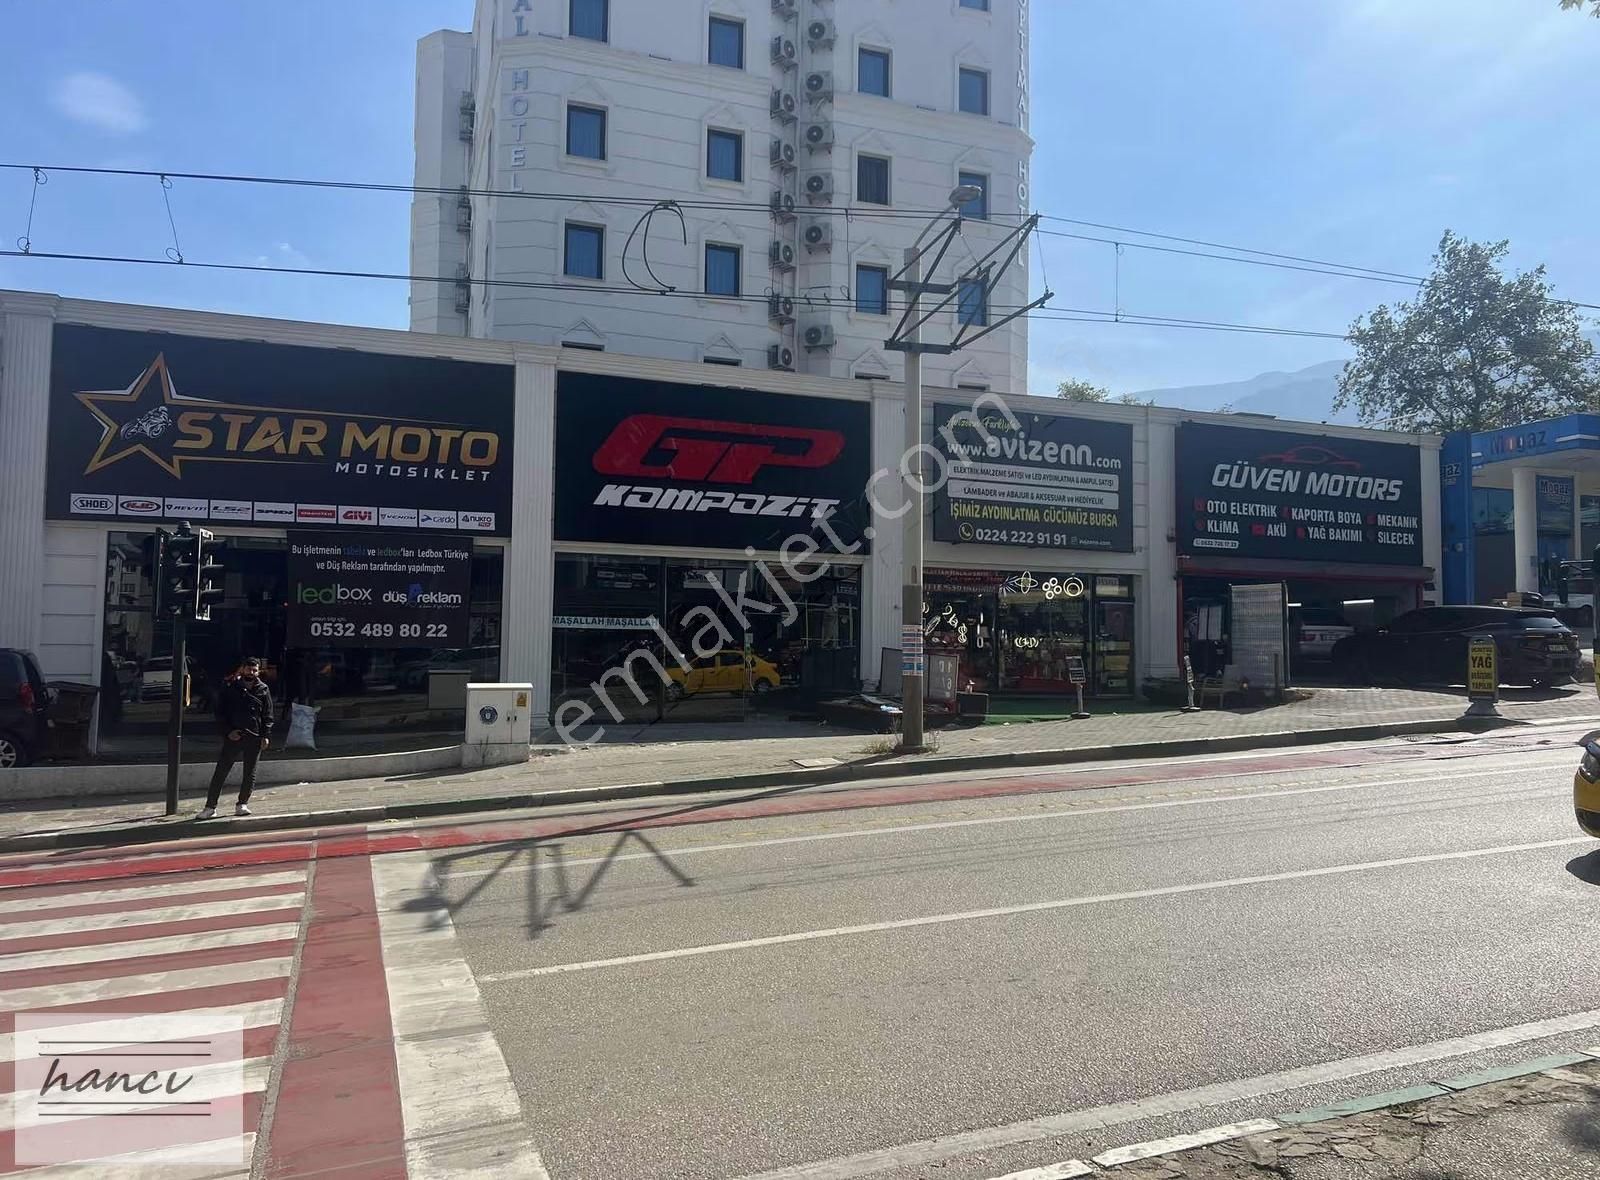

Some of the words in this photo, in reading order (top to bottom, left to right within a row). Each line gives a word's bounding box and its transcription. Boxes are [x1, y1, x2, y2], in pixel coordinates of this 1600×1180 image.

[511, 70, 529, 192] HOTEL
[173, 411, 329, 456] STAR
[339, 421, 499, 466] MOTO
[592, 413, 846, 484] GP
[947, 431, 1122, 470] www.avizenn.com
[1211, 460, 1301, 493] GÜVEN
[1305, 471, 1404, 501] MOTORS
[79, 499, 108, 509] SHOEI
[950, 498, 981, 521] İŞİMİZ
[981, 506, 1040, 523] AYDINLATMA
[1043, 508, 1088, 526] GÜCÜMÜZ
[1089, 513, 1118, 528] BURSA
[1207, 500, 1228, 515] OTO
[1291, 507, 1336, 523] KAPORTA
[1337, 511, 1362, 526] BOYA
[342, 510, 372, 521] GIVI
[975, 527, 1008, 543] 0224
[1010, 530, 1034, 544] 222
[1036, 532, 1051, 545] 91
[1053, 533, 1068, 546] 91
[1266, 522, 1287, 538] AKÜ
[1307, 525, 1328, 541] YAĞ
[1329, 527, 1363, 543] BAKIMI
[291, 544, 302, 555] Bu
[367, 549, 376, 557] ve
[417, 548, 442, 559] Ledbox
[443, 549, 469, 561] Türkiye
[326, 560, 341, 572] Düş
[341, 560, 368, 571] Reklam
[296, 582, 372, 604] ledbox
[382, 590, 408, 605] düş
[416, 591, 462, 604] reklam
[310, 622, 356, 637] 0532
[360, 623, 394, 637] 489
[399, 624, 421, 638] 80
[425, 624, 448, 638] 22
